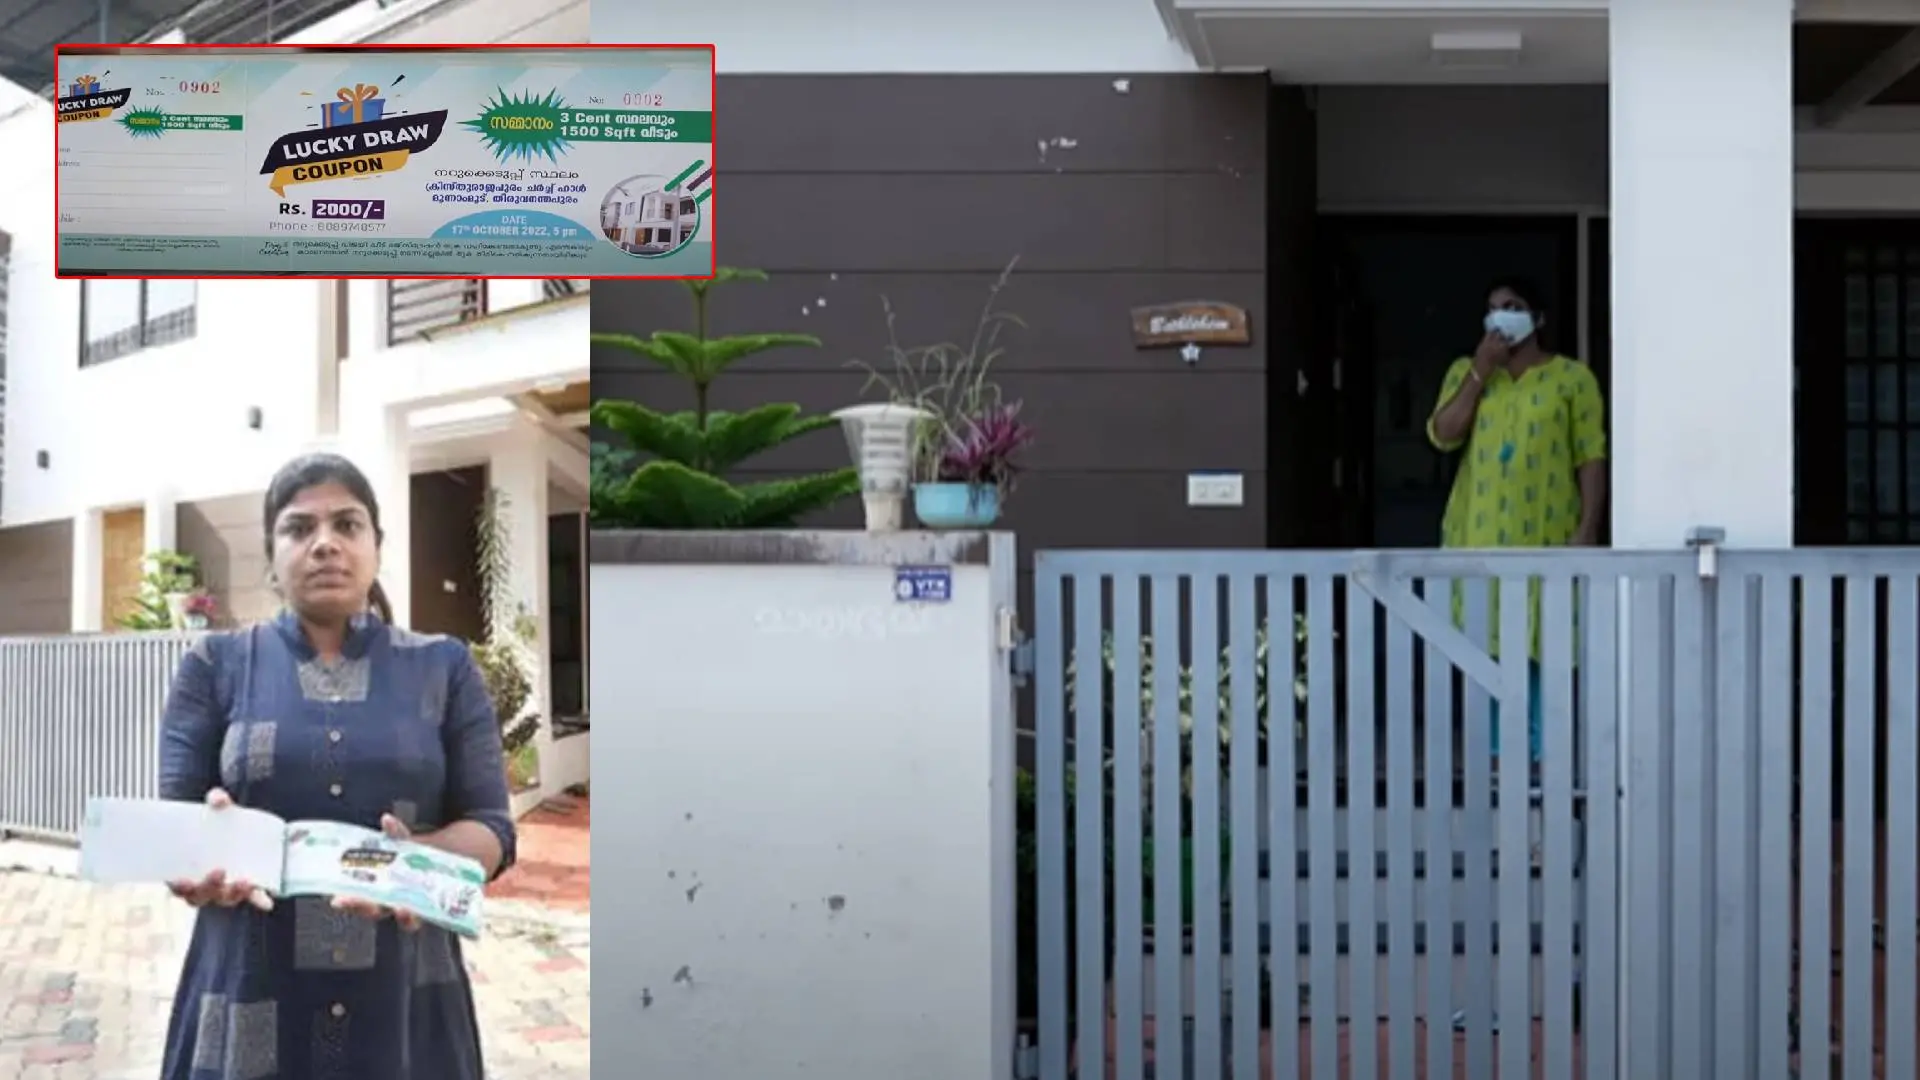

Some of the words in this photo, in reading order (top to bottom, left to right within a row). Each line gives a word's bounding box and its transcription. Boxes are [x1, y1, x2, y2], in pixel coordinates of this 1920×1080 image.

[179, 81, 220, 94] 0902
[58, 98, 87, 111] UCKY
[90, 94, 122, 107] DRAW
[490, 116, 554, 130] സമ്മാനം
[560, 112, 569, 123] 3
[575, 112, 611, 124] Cent
[560, 126, 599, 137] 1500
[604, 126, 635, 140] Sqft
[283, 134, 356, 159] LUCKY
[363, 124, 429, 148] DRAW
[293, 157, 383, 181] COUPON
[279, 202, 306, 215] Rs.
[315, 201, 381, 219] 2000/-
[269, 222, 307, 231] Phone
[502, 215, 527, 225] DATE
[472, 226, 519, 235] OCTOBER
[553, 226, 560, 235] 5
[562, 227, 577, 237] pm
